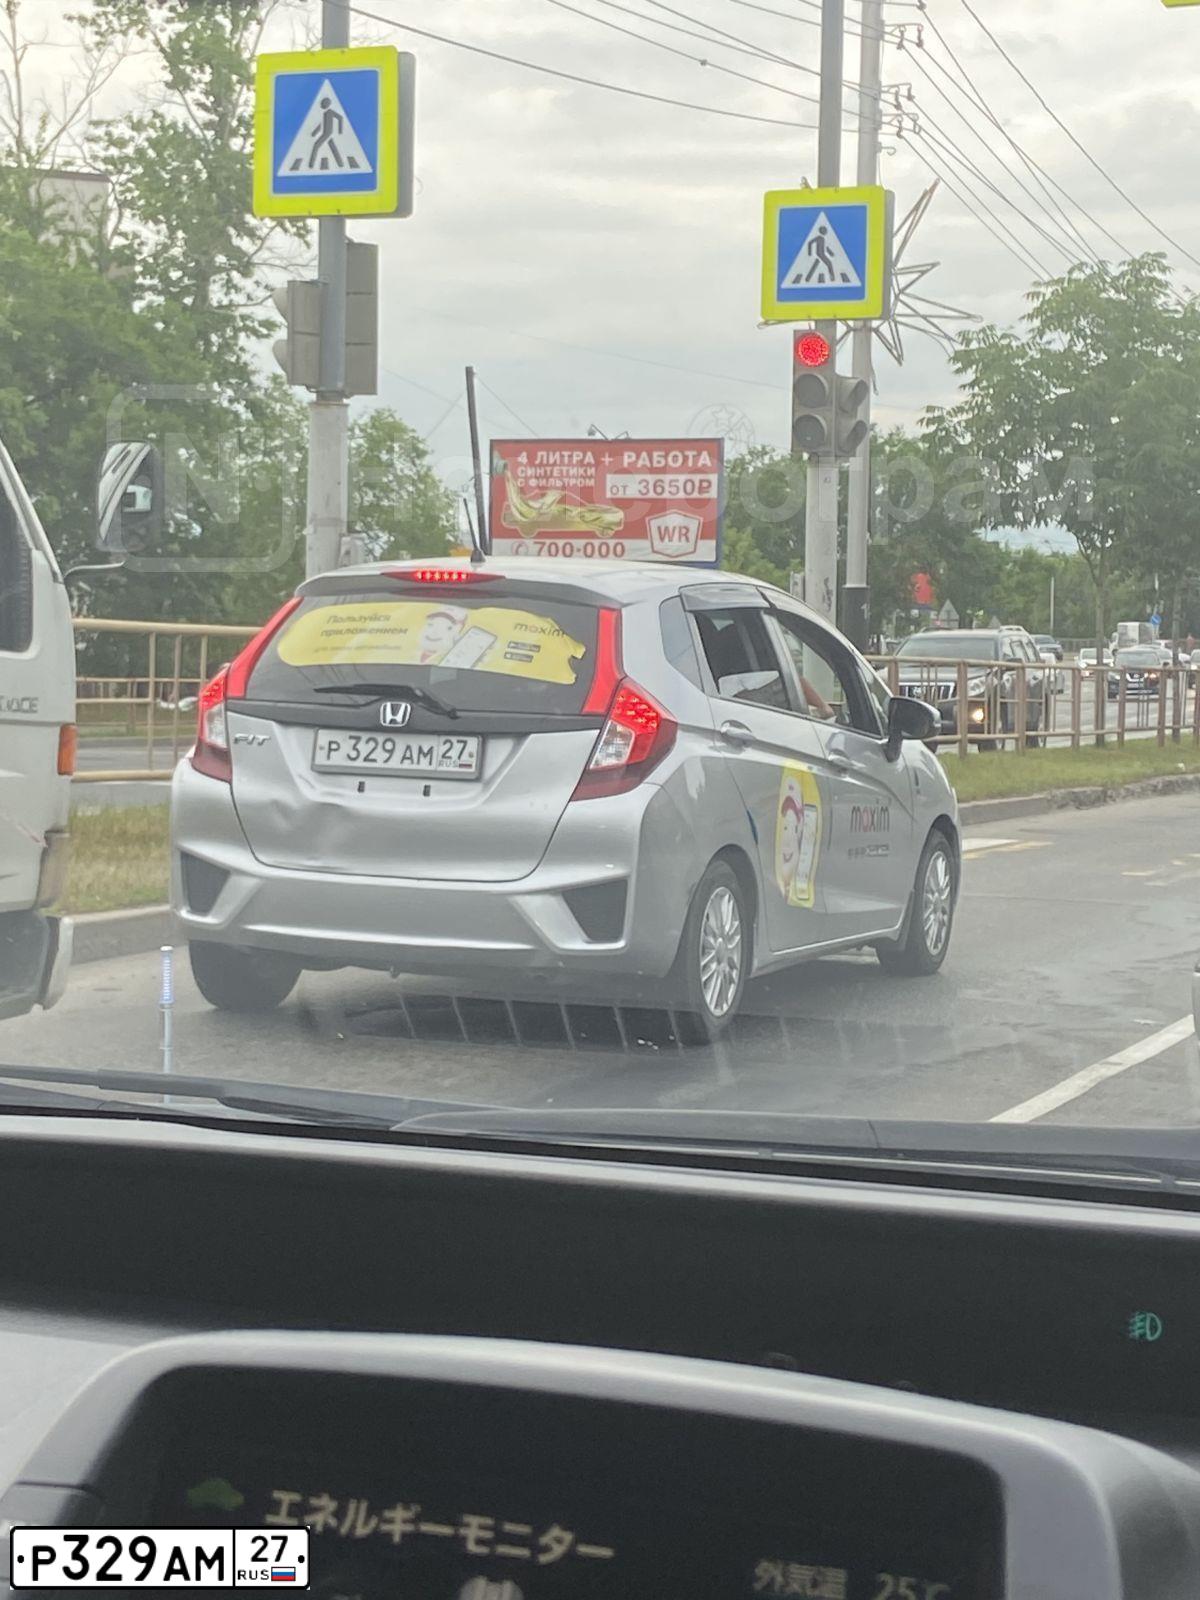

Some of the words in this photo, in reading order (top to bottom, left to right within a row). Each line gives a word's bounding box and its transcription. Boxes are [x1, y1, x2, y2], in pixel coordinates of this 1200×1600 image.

[517, 452, 528, 465] 4
[534, 451, 595, 465] ЛИТРА
[601, 454, 614, 467] +
[623, 451, 712, 468] РАБОТА
[517, 466, 596, 478] СИНТЕТИКИ
[528, 478, 595, 488] ФИЛЬТРОМ
[658, 525, 690, 543] WR
[441, 739, 468, 760] 27
[264, 1489, 616, 1565] エネルギーモニター
